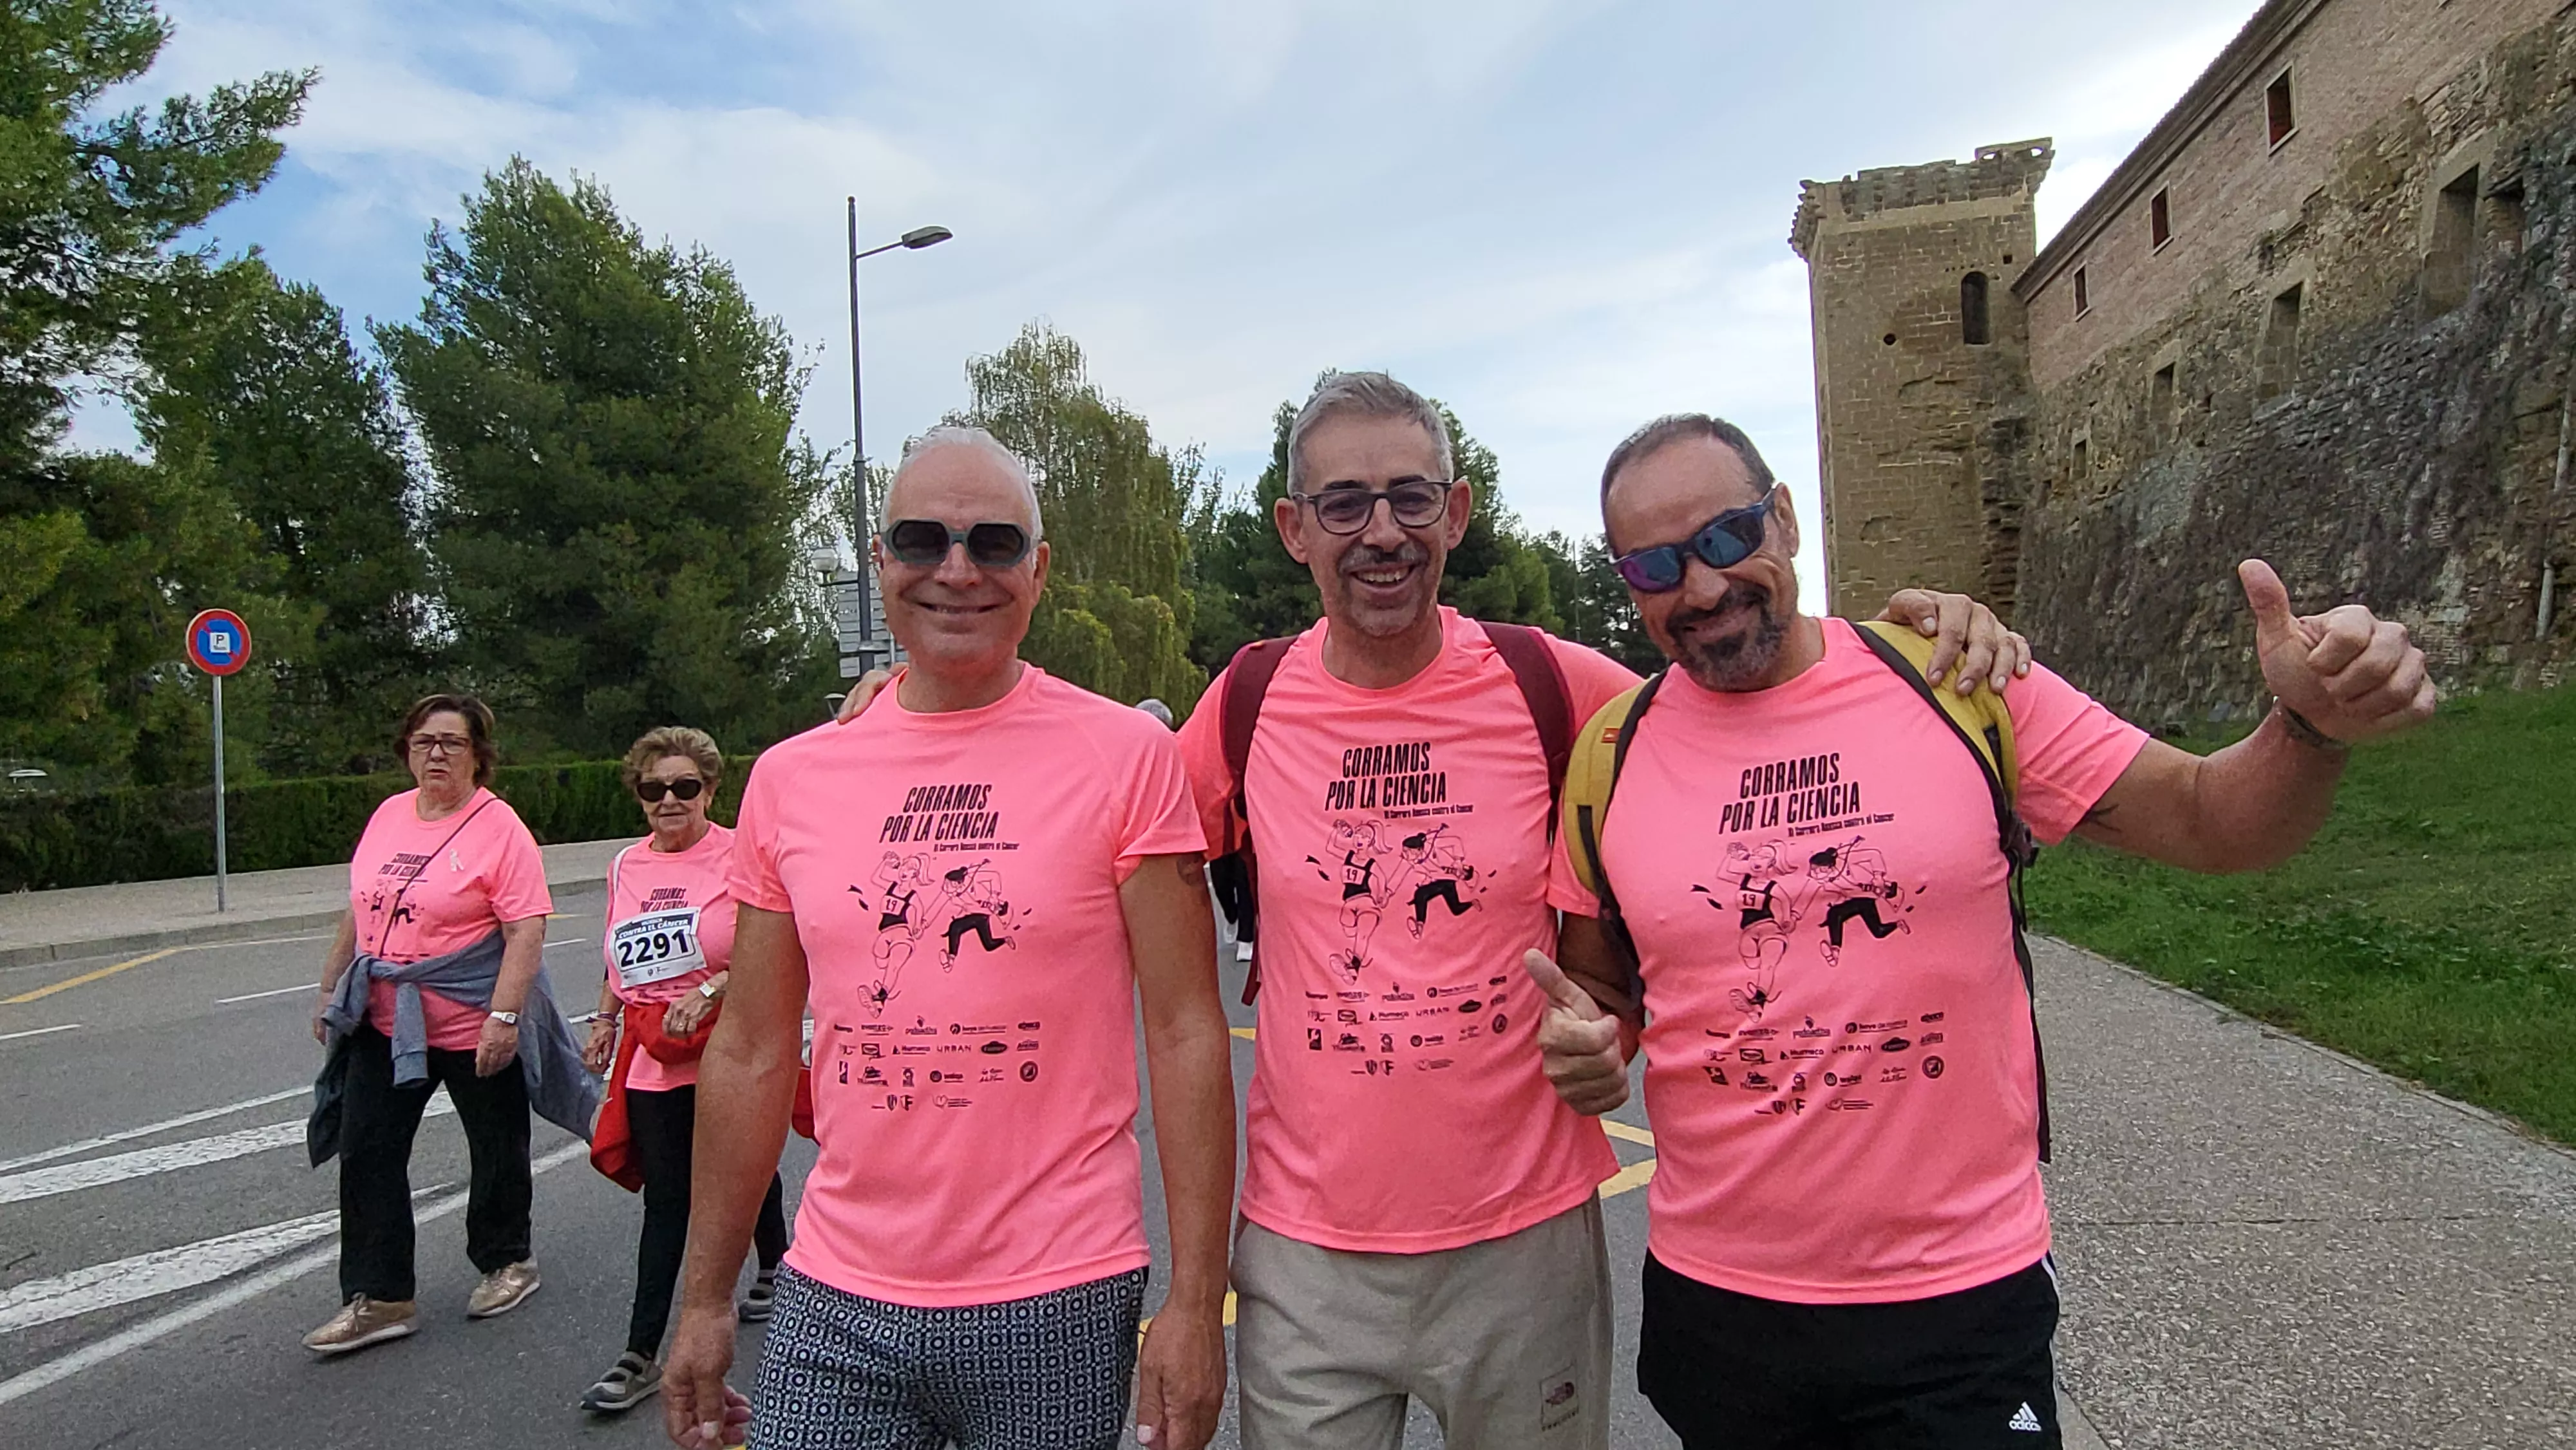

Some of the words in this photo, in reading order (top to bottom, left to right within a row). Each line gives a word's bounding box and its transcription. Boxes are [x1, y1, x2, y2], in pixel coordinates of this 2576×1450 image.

[216, 634, 224, 645] P
[1343, 742, 1430, 778] CORRAMOS
[1740, 753, 1839, 799] CORRAMOS
[903, 784, 992, 813] CORRAMOS
[1325, 780, 1356, 811] POR
[1359, 778, 1376, 809] LA
[1383, 772, 1446, 807] CIENCIA
[1719, 801, 1755, 834] POR
[1760, 796, 1779, 828] LA
[1786, 782, 1860, 824] CIENCIA
[879, 814, 913, 843] POR
[913, 813, 933, 842] LA
[934, 811, 999, 840] CIENCIA
[1346, 868, 1358, 881] 19
[1742, 893, 1756, 907] 19
[618, 929, 688, 967] 2291
[936, 1044, 972, 1053] URBAN
[1832, 1044, 1872, 1053] URBAN
